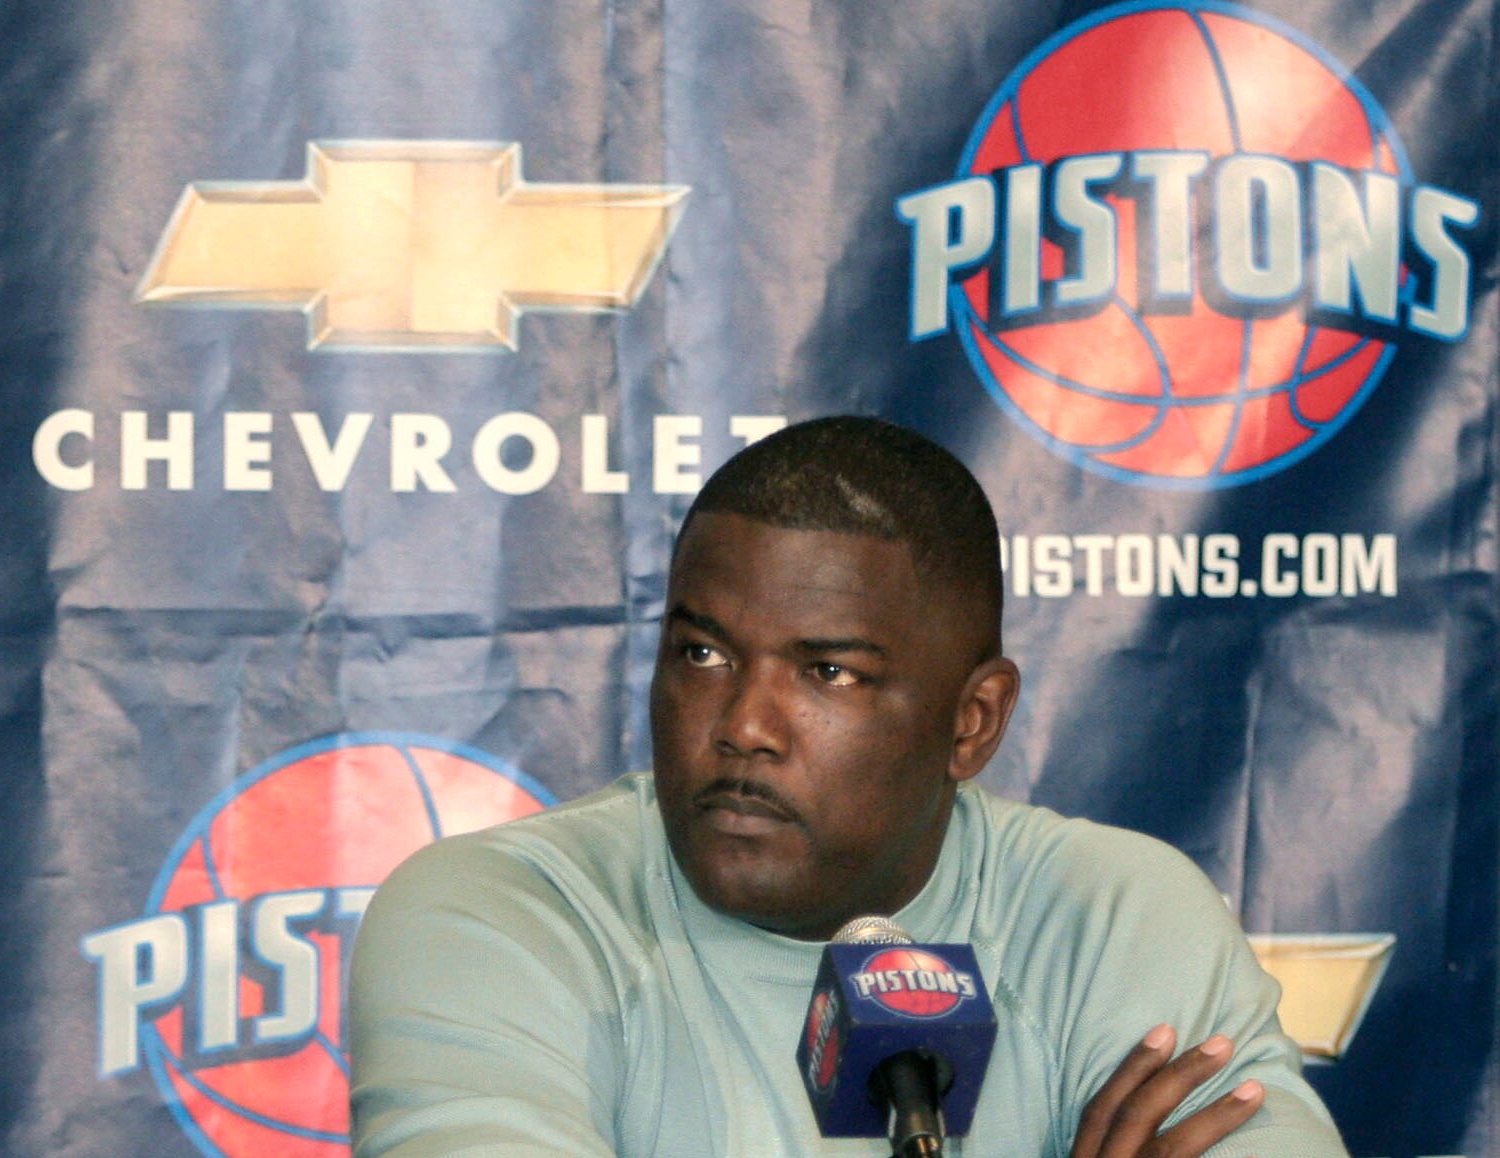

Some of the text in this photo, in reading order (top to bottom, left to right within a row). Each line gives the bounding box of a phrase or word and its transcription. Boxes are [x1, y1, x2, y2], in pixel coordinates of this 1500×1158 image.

[897, 152, 1481, 342] PISTONS
[999, 533, 1397, 598] ISTONS.COM
[81, 885, 379, 1078] PIS
[852, 968, 978, 998] PISTONS
